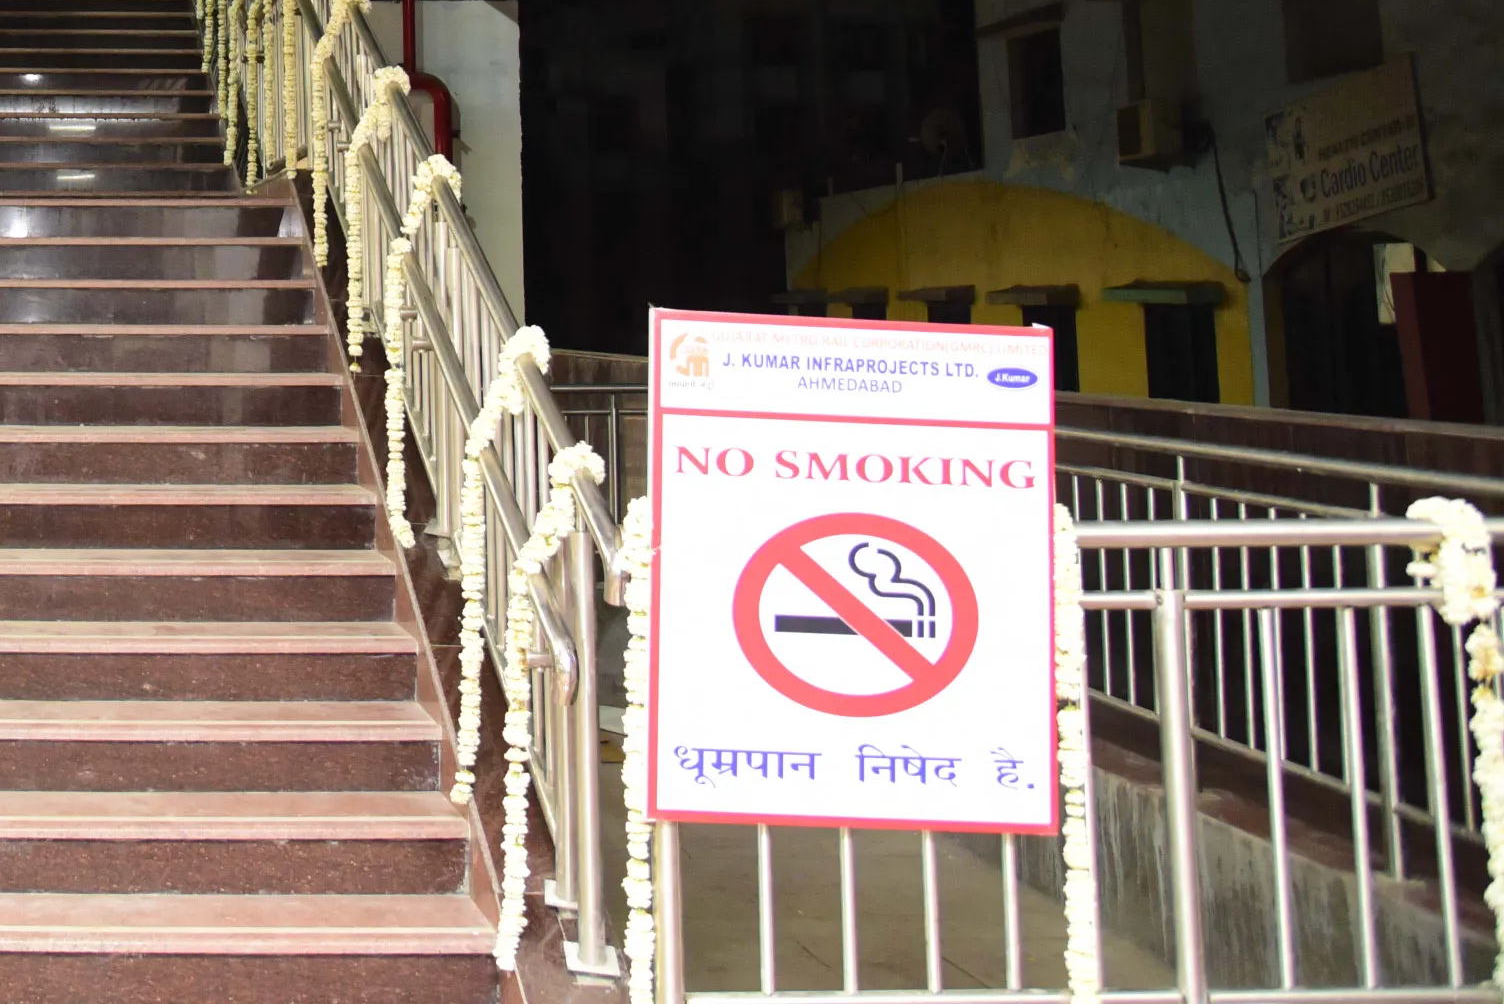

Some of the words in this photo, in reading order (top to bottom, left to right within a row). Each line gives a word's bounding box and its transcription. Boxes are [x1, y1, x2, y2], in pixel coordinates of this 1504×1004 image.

[1320, 159, 1368, 198] Cardio
[1369, 143, 1419, 183] Center
[711, 330, 768, 343] GUJARAT
[821, 335, 849, 347] RAIL
[997, 343, 1049, 357] LIMITED
[722, 353, 736, 368] J.
[742, 353, 800, 371] KUMAR
[806, 356, 940, 377] INFRAPROJECTS
[944, 362, 979, 378] LTD.
[797, 375, 903, 394] AHMEDABAD
[674, 445, 755, 478] NO
[774, 451, 1036, 490] SMOKING
[673, 745, 822, 788] धूम्रपान
